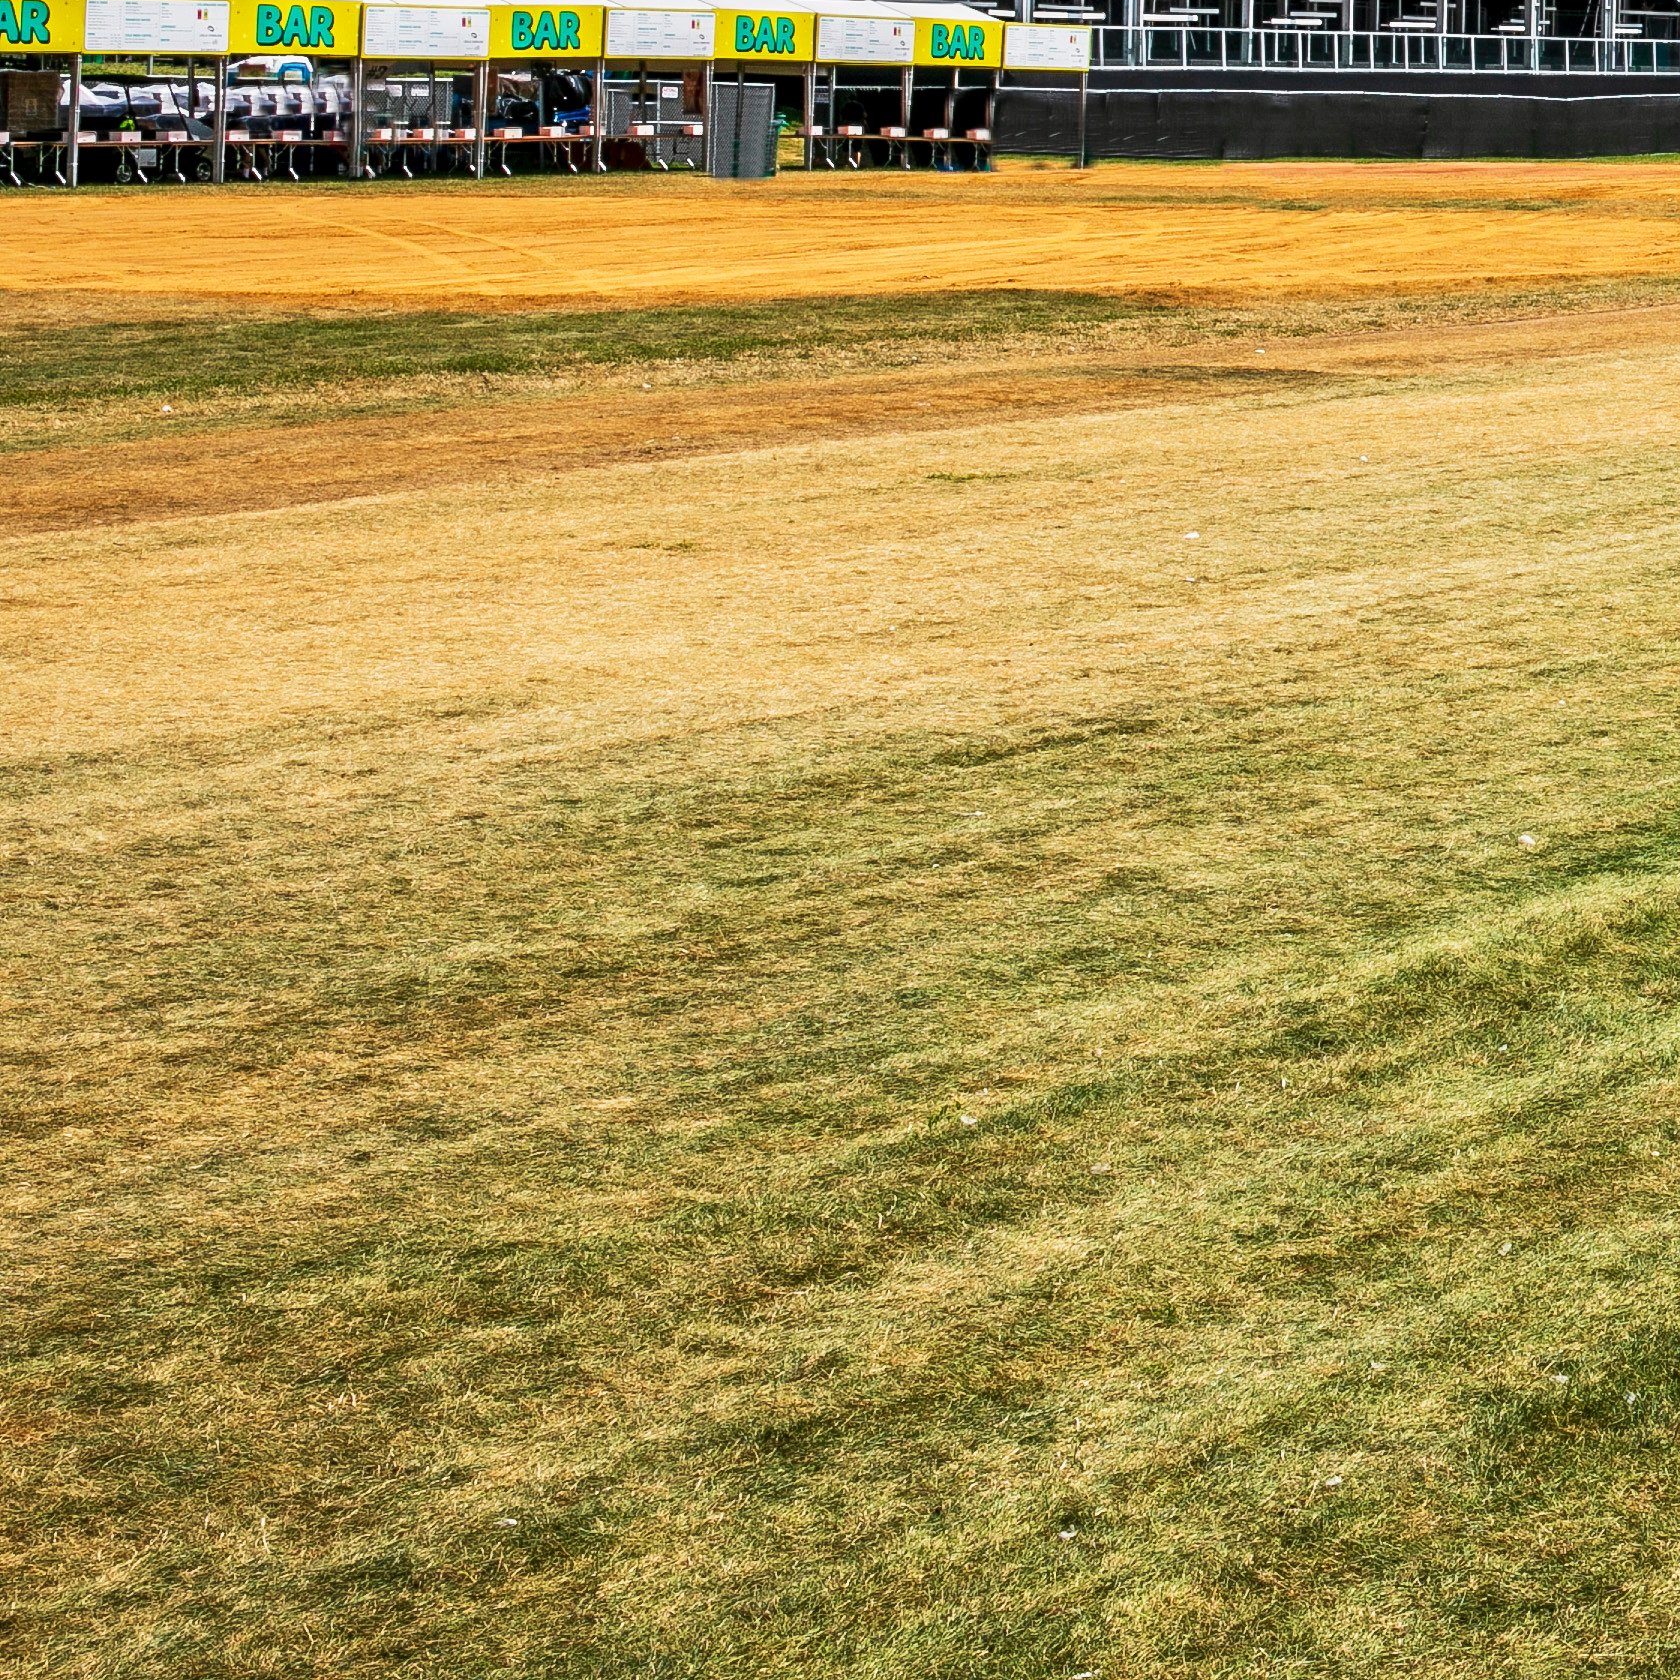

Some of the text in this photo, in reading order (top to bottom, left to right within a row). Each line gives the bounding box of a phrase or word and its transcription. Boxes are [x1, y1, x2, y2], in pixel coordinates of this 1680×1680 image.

[257, 4, 334, 48] BAR
[512, 11, 580, 50] BAR
[735, 15, 795, 54] BAR
[931, 24, 985, 60] BAR
